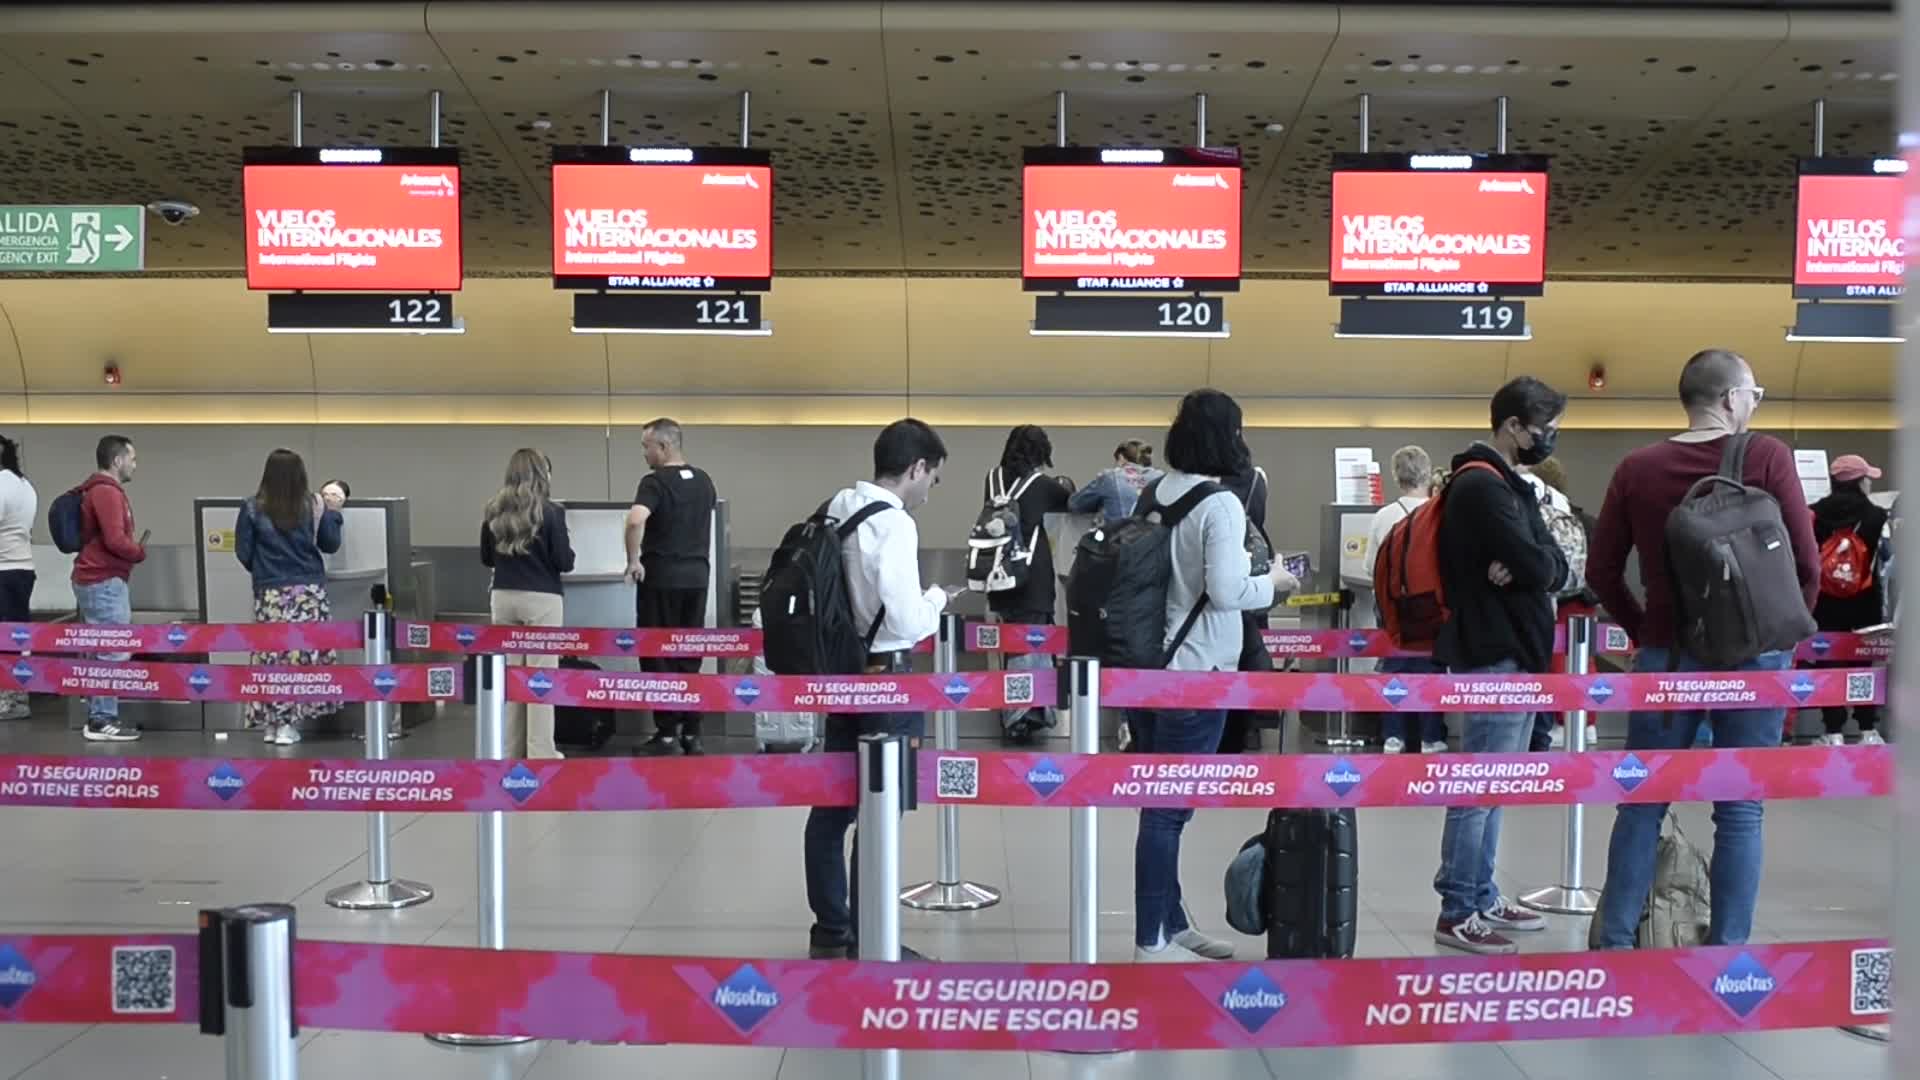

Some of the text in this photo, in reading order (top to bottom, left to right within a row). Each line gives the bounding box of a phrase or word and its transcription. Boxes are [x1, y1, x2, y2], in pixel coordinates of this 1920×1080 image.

[0, 212, 60, 232] LIDA
[256, 210, 337, 228] VUELOS
[564, 209, 648, 228] VUELOS
[1034, 210, 1117, 229] VUELOS
[1342, 215, 1425, 235] VUELOS
[1807, 219, 1887, 238] VUELOS
[0, 235, 60, 246] MERGENCIA
[257, 228, 443, 248] INTERNACIONALES
[565, 228, 758, 249] INTERNACIONALES
[1035, 229, 1227, 250] INTERNACIONALES
[1343, 234, 1531, 255] INTERNACIONALES
[1807, 237, 1905, 257] INTERNAC
[0, 251, 33, 264] GENCY
[608, 276, 702, 288] STAR ALLIANCE
[1077, 277, 1171, 289] STAR ALLIANCE
[1384, 282, 1475, 293] STAR ALLIANCE
[1846, 285, 1904, 296] STAR ALL
[388, 300, 441, 323] 122
[696, 300, 750, 324] 121
[1158, 302, 1211, 326] 120
[1461, 305, 1514, 329] 119
[64, 629, 78, 637] TU
[511, 631, 523, 640] TU
[671, 634, 683, 642] TU
[1262, 635, 1312, 644] EGURIDAD
[56, 638, 142, 648] NO TIENE ESCALAS
[502, 640, 589, 650] NO TIENE ESCALAS
[662, 643, 749, 652] NO TIENE ESCALAS
[72, 666, 149, 679] TU SEGURIDAD
[252, 673, 332, 683] TU SEGURIDAD
[62, 679, 160, 691] NO TIENE ESCALAS
[241, 684, 343, 695] NO TIENE ESCALAS
[598, 678, 688, 690] TU SEGURIDAD
[806, 682, 897, 693] TU SEGURIDAD
[1454, 682, 1542, 693] TU SEGURIDAD
[1658, 680, 1746, 691] TU SEGURIDAD
[586, 690, 700, 703] NO TIENE ESCALAS
[794, 693, 909, 705] NO TIENE ESCALAS
[1440, 693, 1554, 705] NO TIENE ESCALAS
[1645, 691, 1757, 703] NO TIENE ESCALAS
[17, 764, 142, 781] TU SEGURIDAD
[309, 769, 436, 784] TU SEGURIDAD
[1131, 764, 1259, 779] TU SEGURIDAD
[1426, 763, 1549, 777] TU SEGURIDAD
[1, 782, 160, 798] NO TIENE ESCALAS
[292, 786, 453, 801] NO TIENE ESCALAS
[1112, 781, 1275, 796] NO TIENE ESCALAS
[1407, 779, 1565, 794] NO TIENE ESCALAS
[1396, 968, 1607, 997] TU SEGURIDAD
[1714, 974, 1774, 996] Nosotras
[714, 985, 778, 1007] Nosotras
[892, 978, 1110, 1003] TU SEGURIDAD
[1223, 988, 1286, 1009] Nosotras
[1365, 996, 1634, 1026] NO TIENE ESCALAS
[861, 1007, 1139, 1031] NO TIENE ESCALAS
